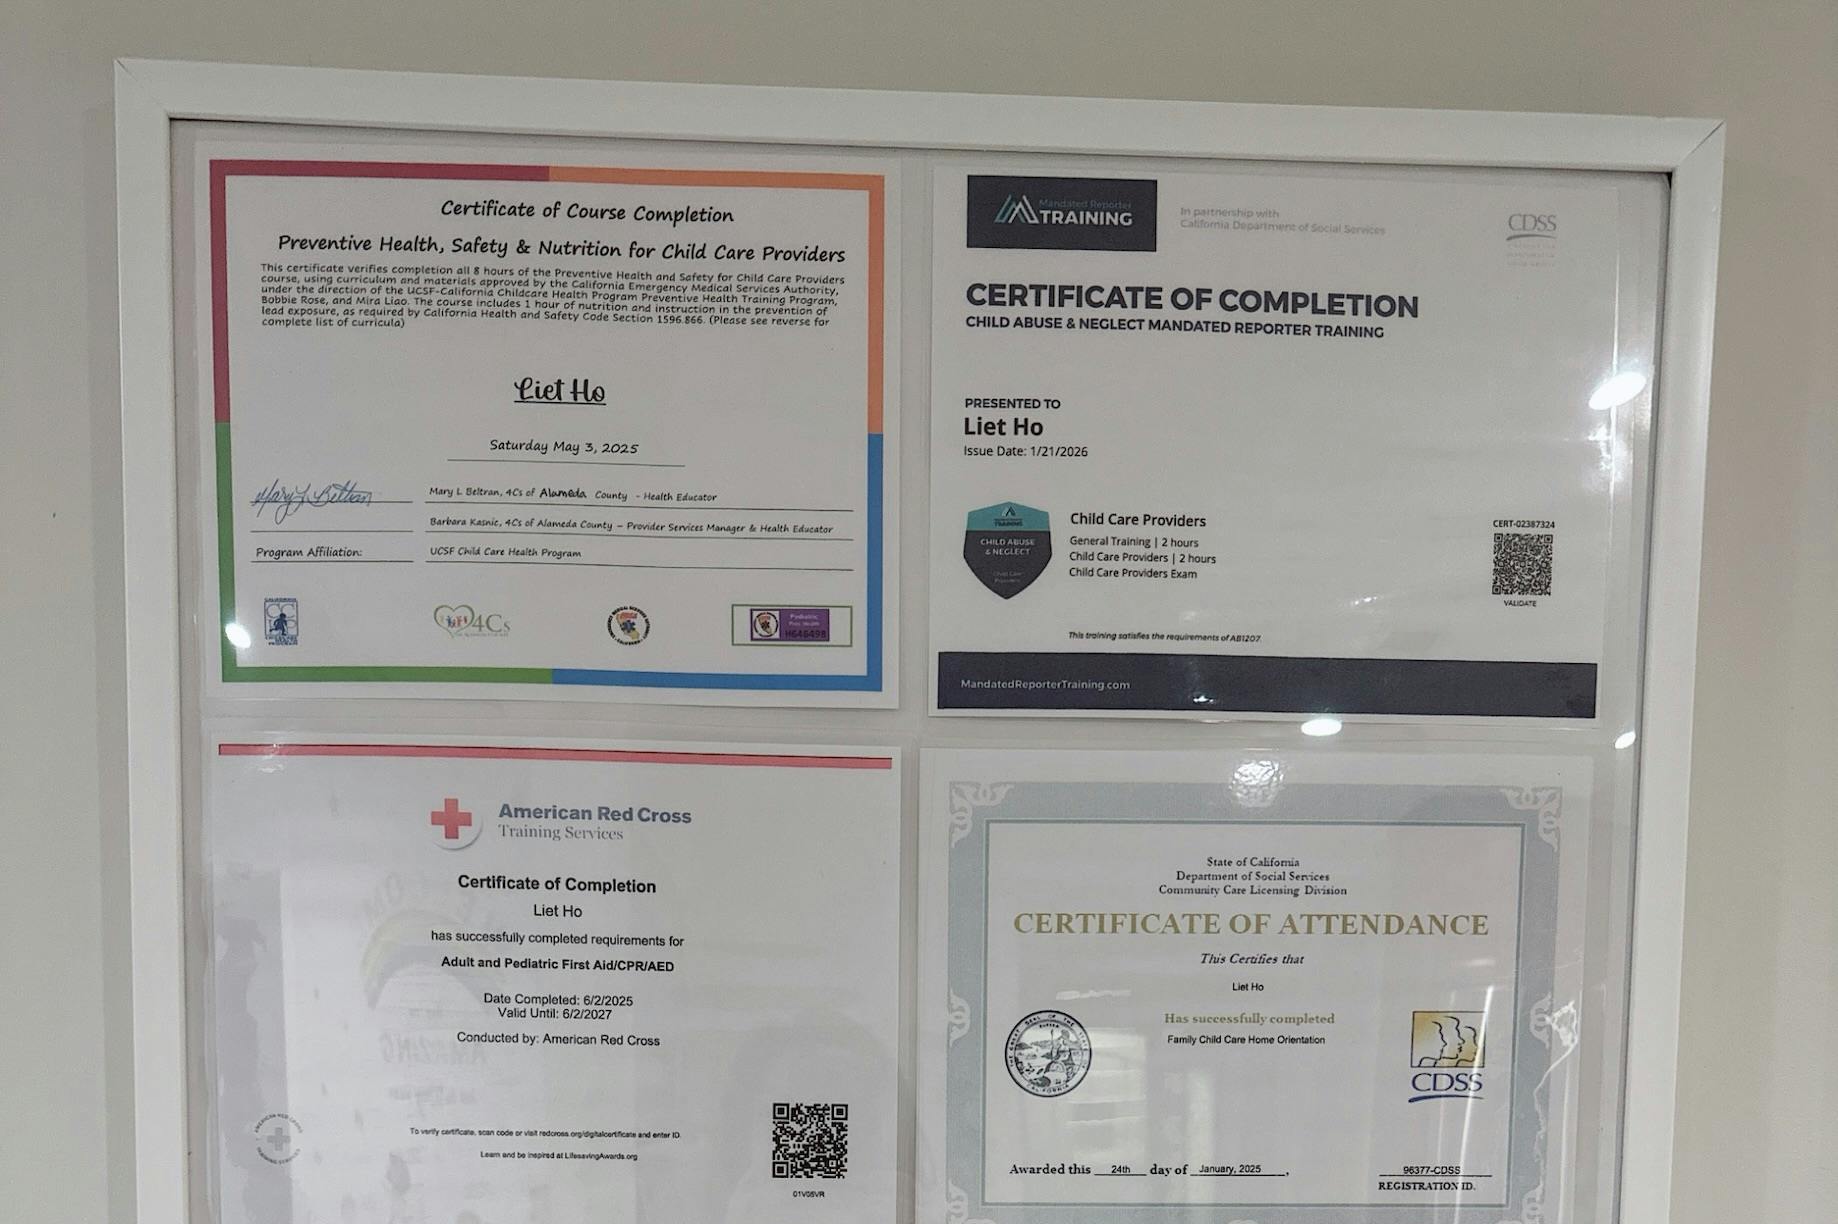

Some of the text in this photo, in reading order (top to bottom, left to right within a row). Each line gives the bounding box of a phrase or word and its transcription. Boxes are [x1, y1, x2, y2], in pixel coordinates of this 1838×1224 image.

[440, 199, 734, 226] Certificate of Course Completion
[1036, 209, 1132, 226] TRAINING
[1507, 212, 1557, 235] CDSS
[278, 233, 845, 263] Preventive Health, Safety & Nutrition for Child Care Providers
[966, 281, 1418, 318] CERTIFICATE OF COMPLETION
[261, 315, 405, 328] complete list of curricula)
[965, 315, 1384, 338] CHILD ABUSE & NEGLECT MANDATED REPORTER TRAINING
[513, 376, 605, 402] Liet Ho
[964, 397, 1061, 409] PRESENTED TO
[964, 415, 1043, 436] Liet Ho
[490, 438, 639, 456] Saturday May 3, 2025
[964, 445, 1088, 457] Issue Date: 1/21/2026
[429, 487, 453, 498] Mary
[456, 487, 462, 495] L
[505, 487, 523, 496] 4Cs
[525, 487, 536, 497] of
[538, 486, 587, 499] Alameda
[594, 490, 627, 502] County
[643, 491, 673, 501] Health
[676, 492, 717, 502] Educator
[1070, 511, 1206, 527] Child Care Providers
[1503, 599, 1536, 607] VALIDATE
[471, 612, 511, 636] 4Cs
[960, 678, 1130, 691] MandatedReporterTraining.com
[498, 803, 692, 824] American Red Cross
[497, 823, 623, 841] Training Services
[1206, 856, 1300, 868] State of California
[457, 874, 656, 896] Certificate of Completion
[533, 903, 582, 918] Liet Ho
[1013, 912, 1488, 935] CERTIFICATE OF ATTENDANCE
[431, 930, 684, 948] has successfully completed requirements for
[440, 955, 674, 972] Adult and Pediatric First Aid/CPR/AED
[1200, 952, 1304, 964] This Certifies that
[1232, 981, 1264, 991] Liet Ho
[483, 992, 633, 1007] Date Completed: 6/2/2025
[497, 1005, 612, 1020] Valid Until: 6/2/2027
[1164, 1011, 1335, 1026] Has successfully completed
[1167, 1034, 1325, 1046] Family Child Care Home Orientation
[1411, 1071, 1483, 1092] CDSS
[1009, 1162, 1261, 1179] Awarded this 24th day of January, 2025
[1378, 1180, 1459, 1191] REGISTRATION
